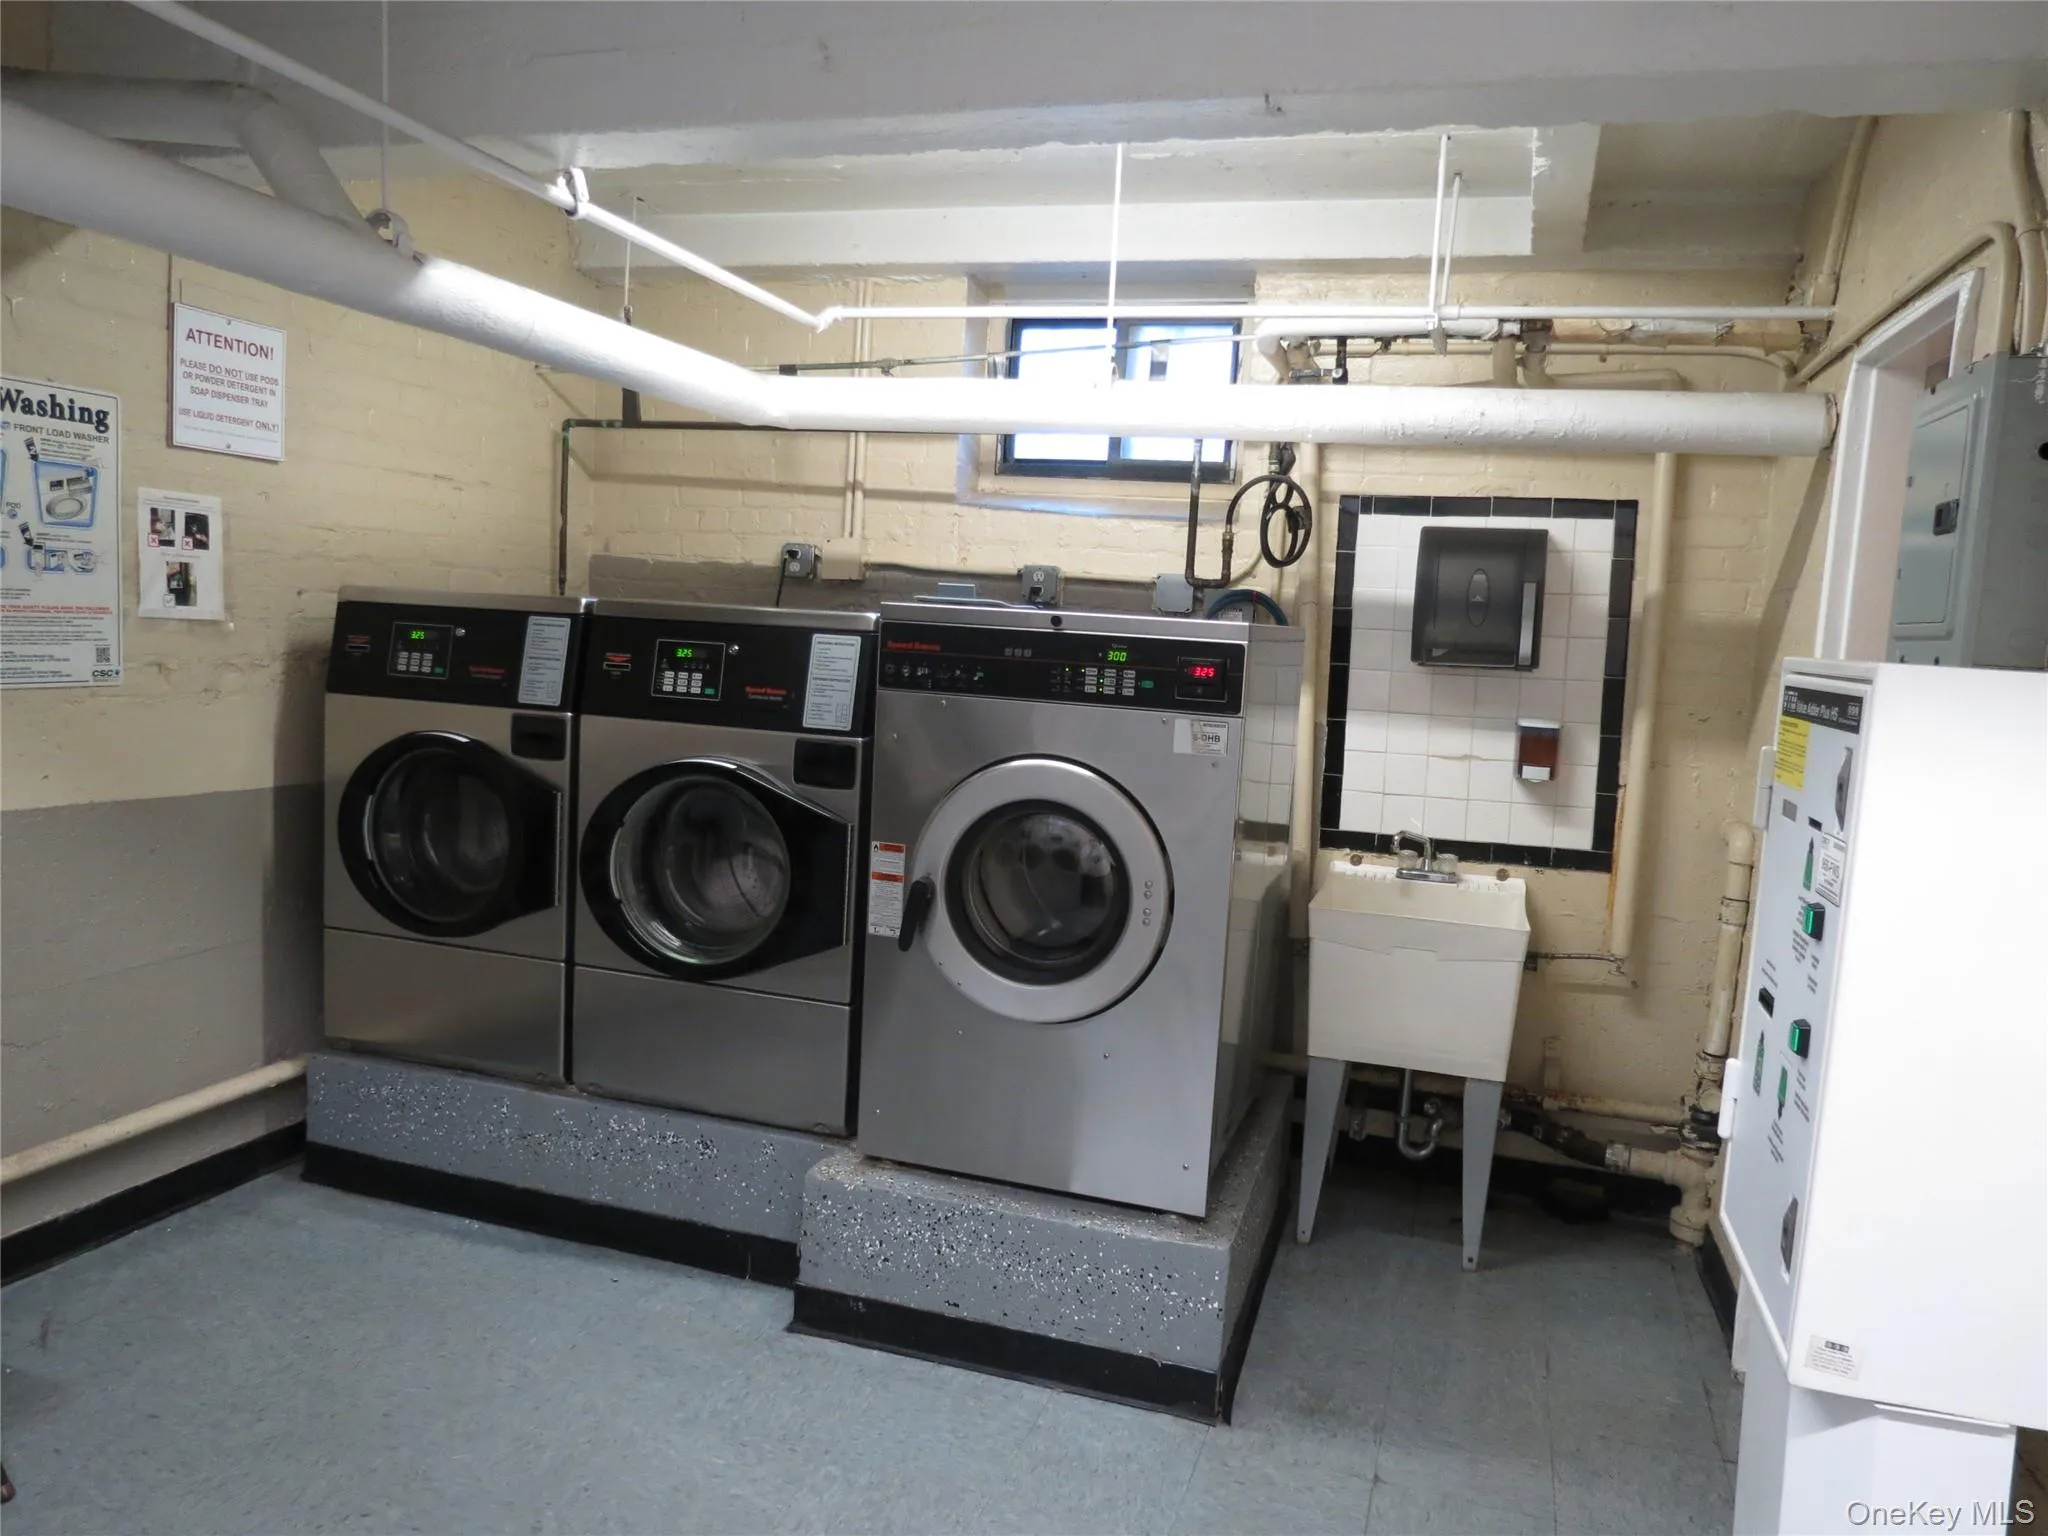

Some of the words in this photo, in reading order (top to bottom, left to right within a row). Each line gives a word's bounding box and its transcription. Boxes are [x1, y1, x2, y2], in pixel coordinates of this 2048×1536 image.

[185, 328, 274, 361] ATTENTION!
[180, 358, 207, 372] PLEASE
[208, 364, 222, 375] DO
[224, 367, 243, 379] NOT
[244, 372, 259, 383] USE
[260, 375, 279, 386] PODS
[182, 371, 194, 381] OR
[195, 373, 225, 387] POWDER
[226, 380, 267, 396] DETERGENT
[268, 389, 276, 397] IN
[190, 386, 210, 397] SOAP
[211, 390, 249, 405] DISPENSER
[251, 397, 269, 408] TRAY
[0, 386, 109, 434] Washing
[178, 407, 192, 417] USE
[193, 410, 214, 421] LIQUID
[215, 413, 254, 428] DETERGENT
[255, 420, 279, 433] ONLY!
[14, 424, 43, 435] FRONT
[47, 428, 71, 439] LOAD
[73, 432, 110, 445] WASHER
[410, 631, 426, 640] 325
[676, 648, 693, 658] 325
[1107, 650, 1127, 662] 300
[92, 669, 114, 678] CSC
[1194, 666, 1215, 678] 325
